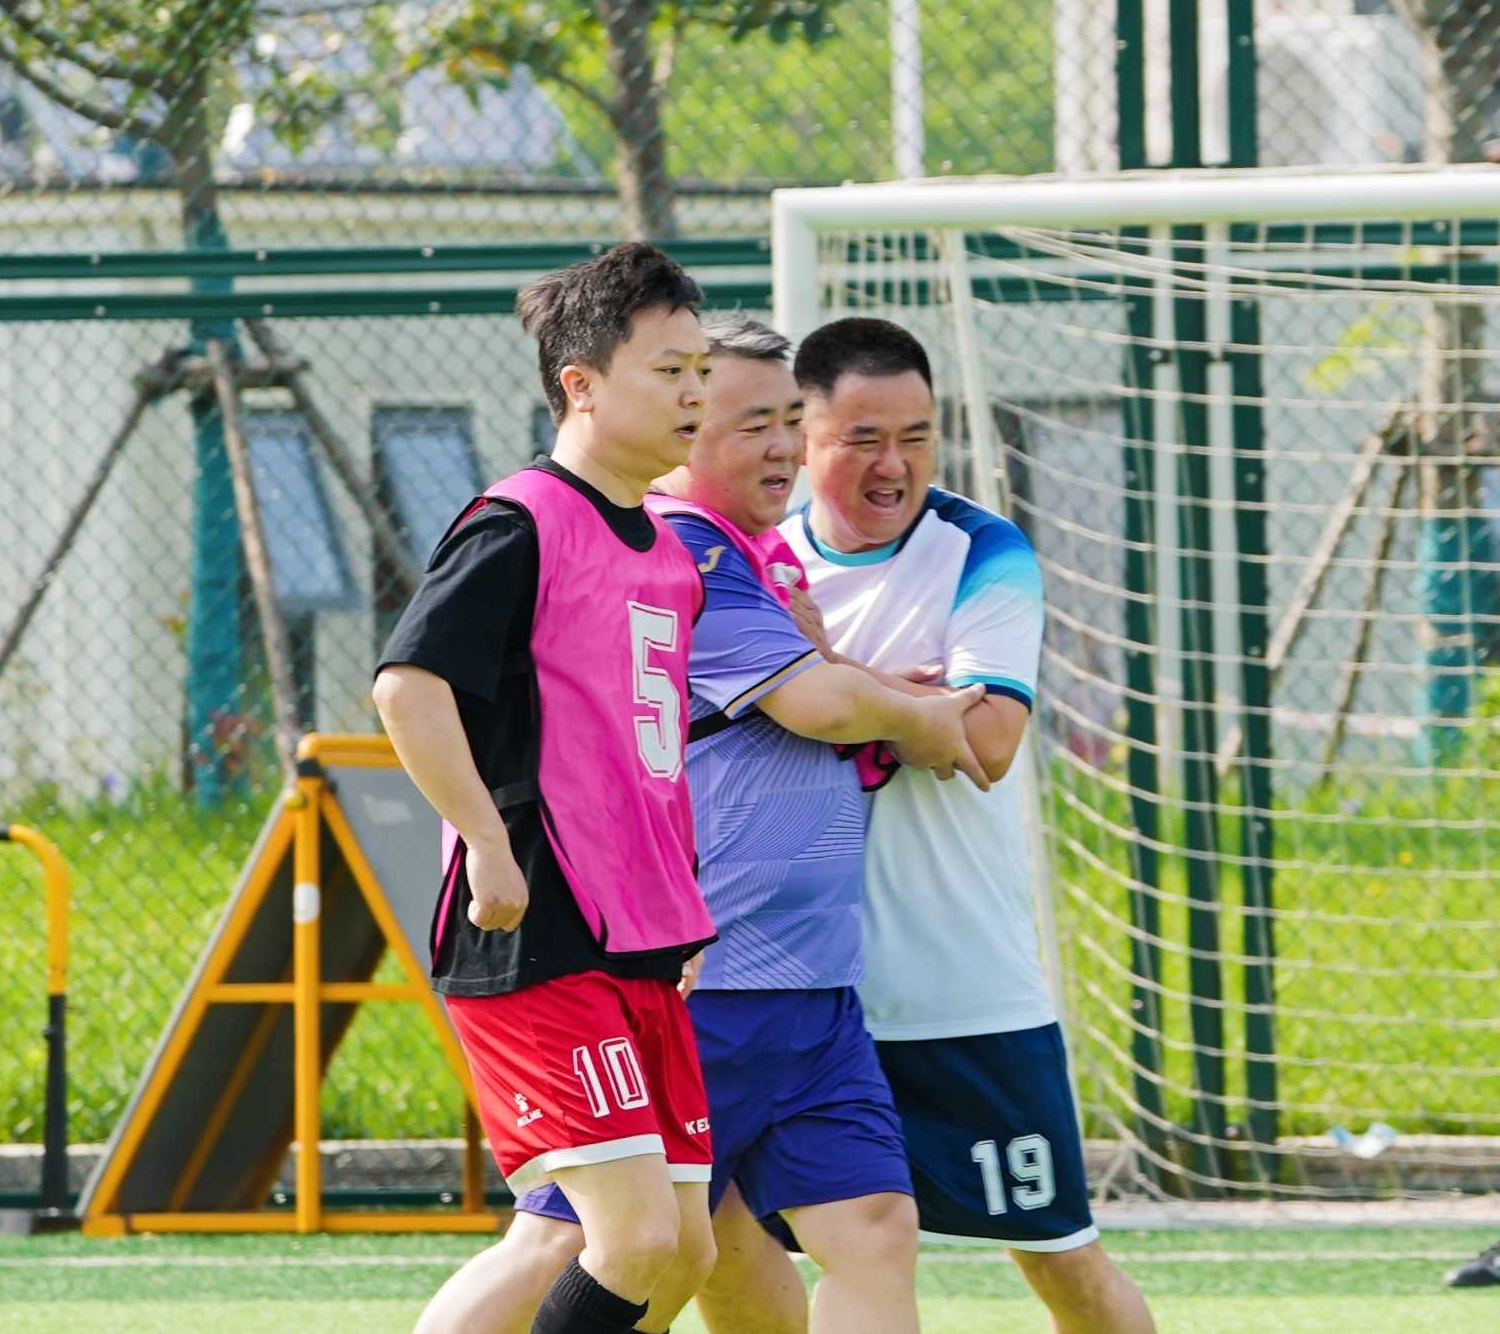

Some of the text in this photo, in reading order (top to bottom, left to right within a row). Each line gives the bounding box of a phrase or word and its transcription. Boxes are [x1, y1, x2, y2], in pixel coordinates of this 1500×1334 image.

[626, 599, 684, 783] 5
[571, 1036, 650, 1118] 10
[969, 1133, 1056, 1216] 19
